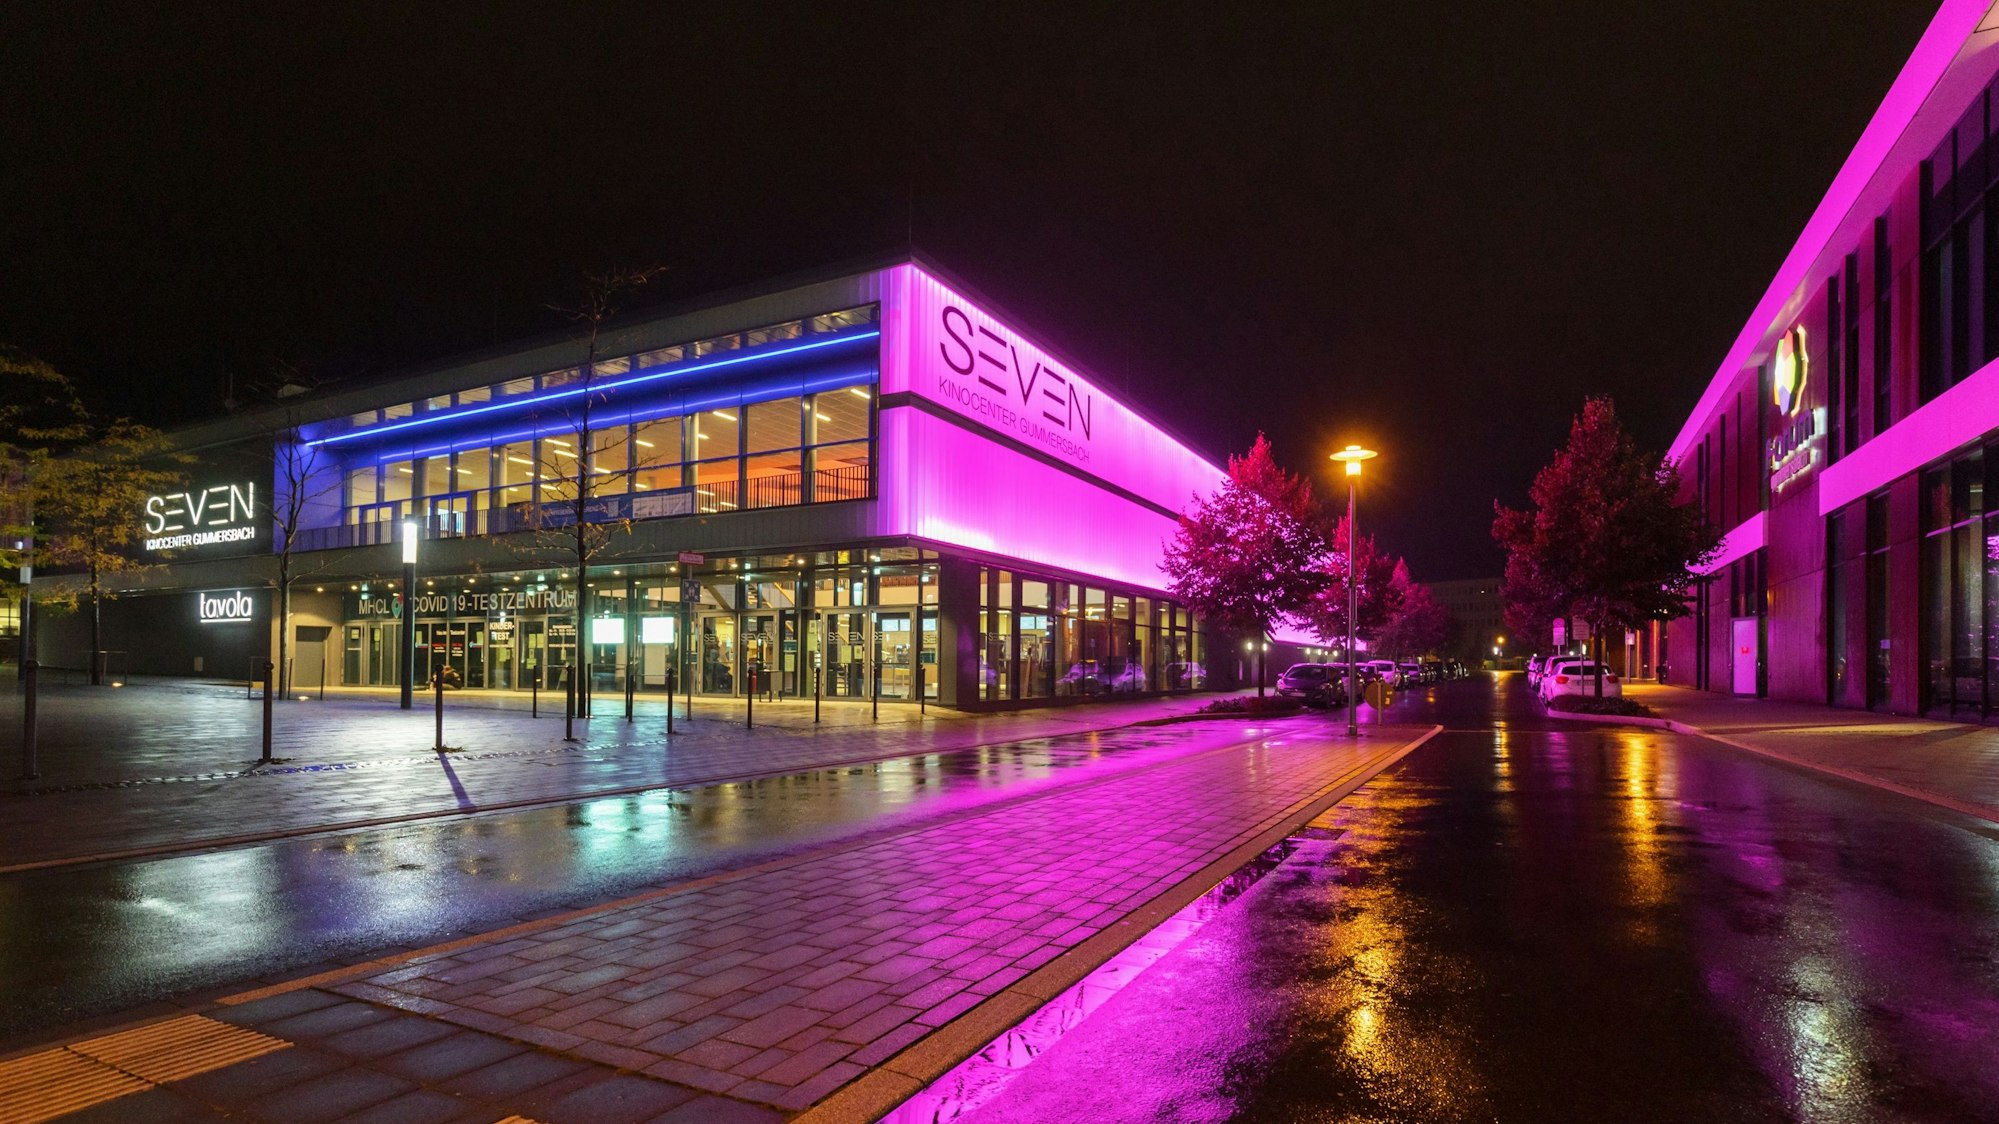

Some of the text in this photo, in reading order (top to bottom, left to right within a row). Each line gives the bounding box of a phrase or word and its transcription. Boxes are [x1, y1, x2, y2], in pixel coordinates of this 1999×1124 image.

[940, 305, 1091, 441] SEVEN
[938, 375, 1091, 464] KINOCENTER GUMMERSBACH
[145, 481, 255, 535] SEVEN
[145, 526, 255, 551] KINOCENTER GUMMERSBACH
[199, 590, 253, 619] tavola
[358, 598, 390, 616] MHCL
[489, 621, 515, 631] KINDER-
[494, 631, 510, 641] TEST
